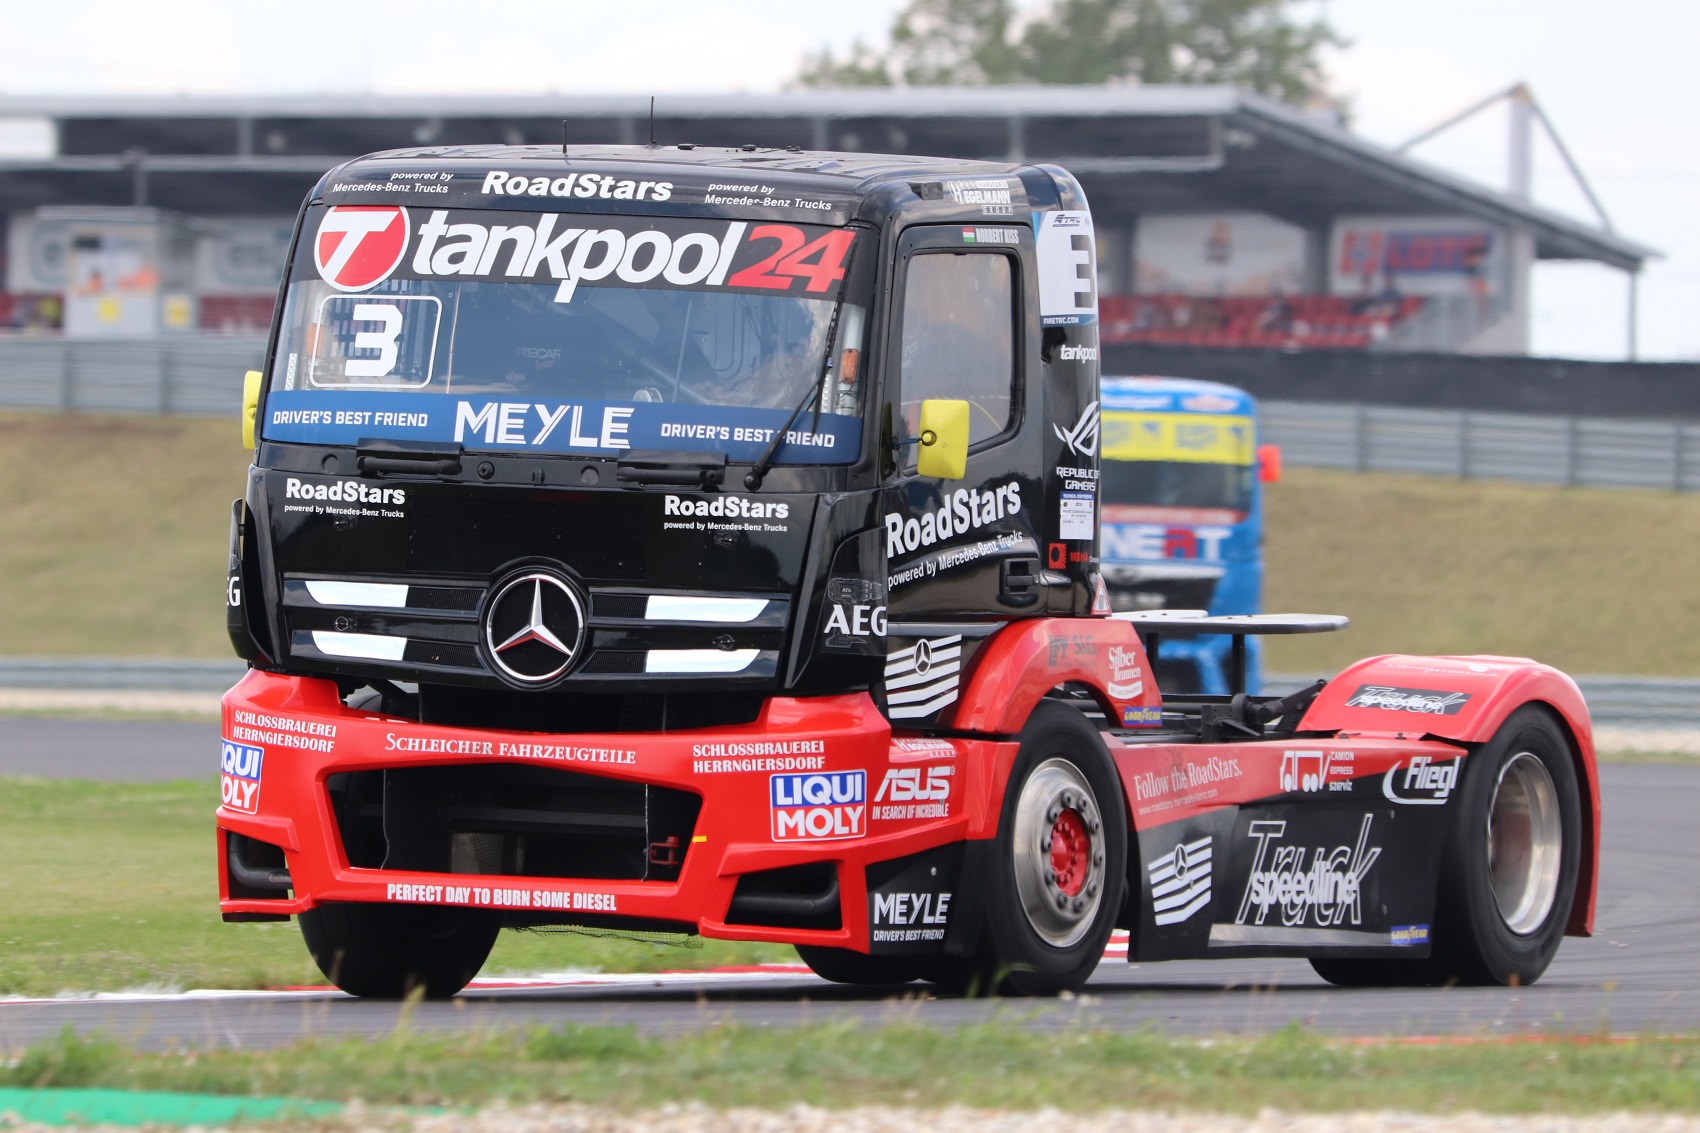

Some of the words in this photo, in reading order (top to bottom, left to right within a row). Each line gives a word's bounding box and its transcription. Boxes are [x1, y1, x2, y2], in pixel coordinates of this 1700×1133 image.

[332, 182, 411, 193] Mercedes-Benz
[414, 183, 448, 194] Trucks
[390, 172, 438, 181] powered
[440, 172, 454, 182] by
[482, 170, 673, 202] RoadStars
[708, 183, 758, 193] powered
[761, 185, 776, 195] by
[794, 198, 832, 210] Trucks
[975, 228, 1004, 243] NORBERT
[1004, 229, 1019, 244] KISS
[412, 210, 857, 303] tankpool24
[1071, 235, 1096, 308] 3
[345, 304, 403, 377] 3
[273, 410, 332, 425] DRIVER'S
[336, 412, 372, 426] BEST
[375, 412, 428, 427] FRIEND
[454, 400, 635, 449] MEYLE
[660, 423, 730, 440] DRIVER'S
[734, 427, 773, 443] BEST
[778, 430, 835, 448] RIEND
[286, 478, 405, 505] RoadStars
[1065, 480, 1096, 492] GAMERS
[284, 504, 314, 512] powered
[316, 506, 325, 514] by
[326, 506, 379, 517] Mercedes-Benz
[381, 509, 405, 518] Trucks
[664, 494, 789, 519] RoadStars
[885, 481, 1022, 559] RoadStars
[664, 522, 694, 530] powered
[696, 522, 706, 531] by
[708, 522, 762, 532] Mercedes-Benz
[763, 524, 788, 532] Trucks
[888, 564, 924, 592] powered
[926, 560, 938, 578] by
[938, 540, 999, 571] Mercedes-Benz
[997, 530, 1023, 551] Trucks
[824, 604, 888, 637] AEG
[1108, 646, 1136, 670] Silber
[1345, 686, 1468, 715] Truck
[1360, 695, 1444, 710] speedline
[234, 710, 337, 738] SCHLOSSBRAUEREI
[233, 726, 336, 753] HERRNGIERSDORF
[693, 740, 825, 758] SCHLOSSBRAUEREI
[693, 756, 825, 774] HERRNGIERSDORF
[1330, 751, 1354, 761] CAMION
[1134, 772, 1169, 801] Follow
[1171, 766, 1188, 792] the
[1188, 756, 1243, 786] RoadStars.
[1330, 766, 1354, 774] EXPRESS
[1404, 756, 1461, 798] Fliegl
[222, 775, 258, 809] OLY
[776, 773, 863, 806] LIQUI
[777, 805, 865, 838] MOLY
[872, 806, 881, 820] IN
[882, 805, 907, 820] SEARCH
[907, 805, 916, 819] OF
[916, 804, 950, 818] INCREDIBLE
[1235, 813, 1382, 926] Truck
[387, 884, 443, 903] PERFECT
[446, 886, 471, 904] DAY
[473, 888, 490, 906] TO
[494, 889, 531, 908] BURN
[533, 891, 571, 909] SOME
[573, 894, 617, 912] DIESEL
[1252, 861, 1358, 915] speedline
[874, 893, 952, 924] MEYLE
[874, 930, 906, 942] DRIVER'S
[906, 930, 922, 941] BEST
[922, 929, 944, 940] FRIEND
